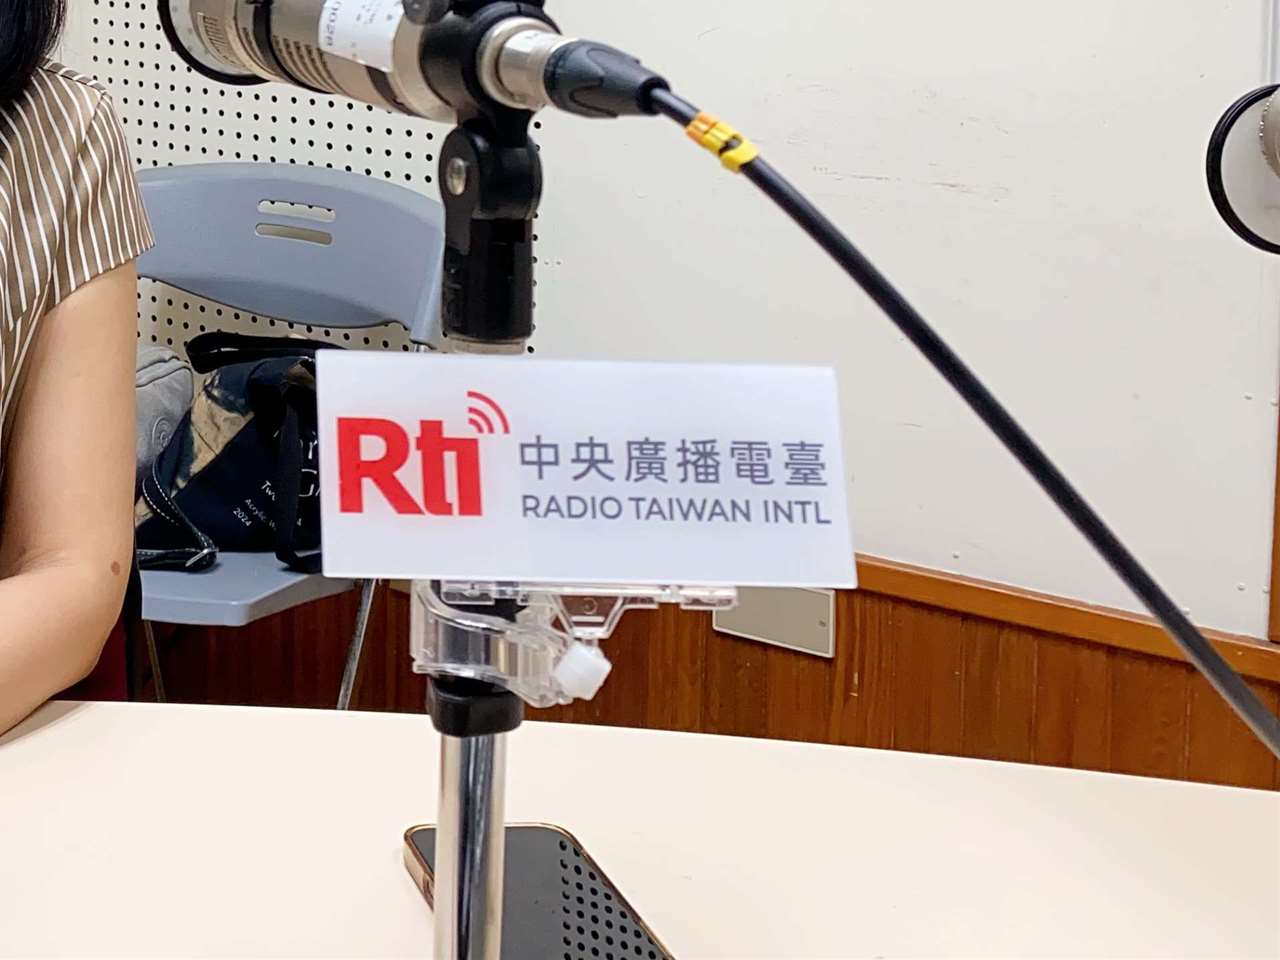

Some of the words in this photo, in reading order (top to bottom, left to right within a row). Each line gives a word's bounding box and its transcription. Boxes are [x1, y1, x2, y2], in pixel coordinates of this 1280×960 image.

[519, 434, 828, 487] 中央廣播電臺
[232, 507, 253, 527] 2024
[521, 494, 623, 520] RADIO
[627, 496, 752, 523] TAIWAN
[763, 499, 833, 525] INTL
